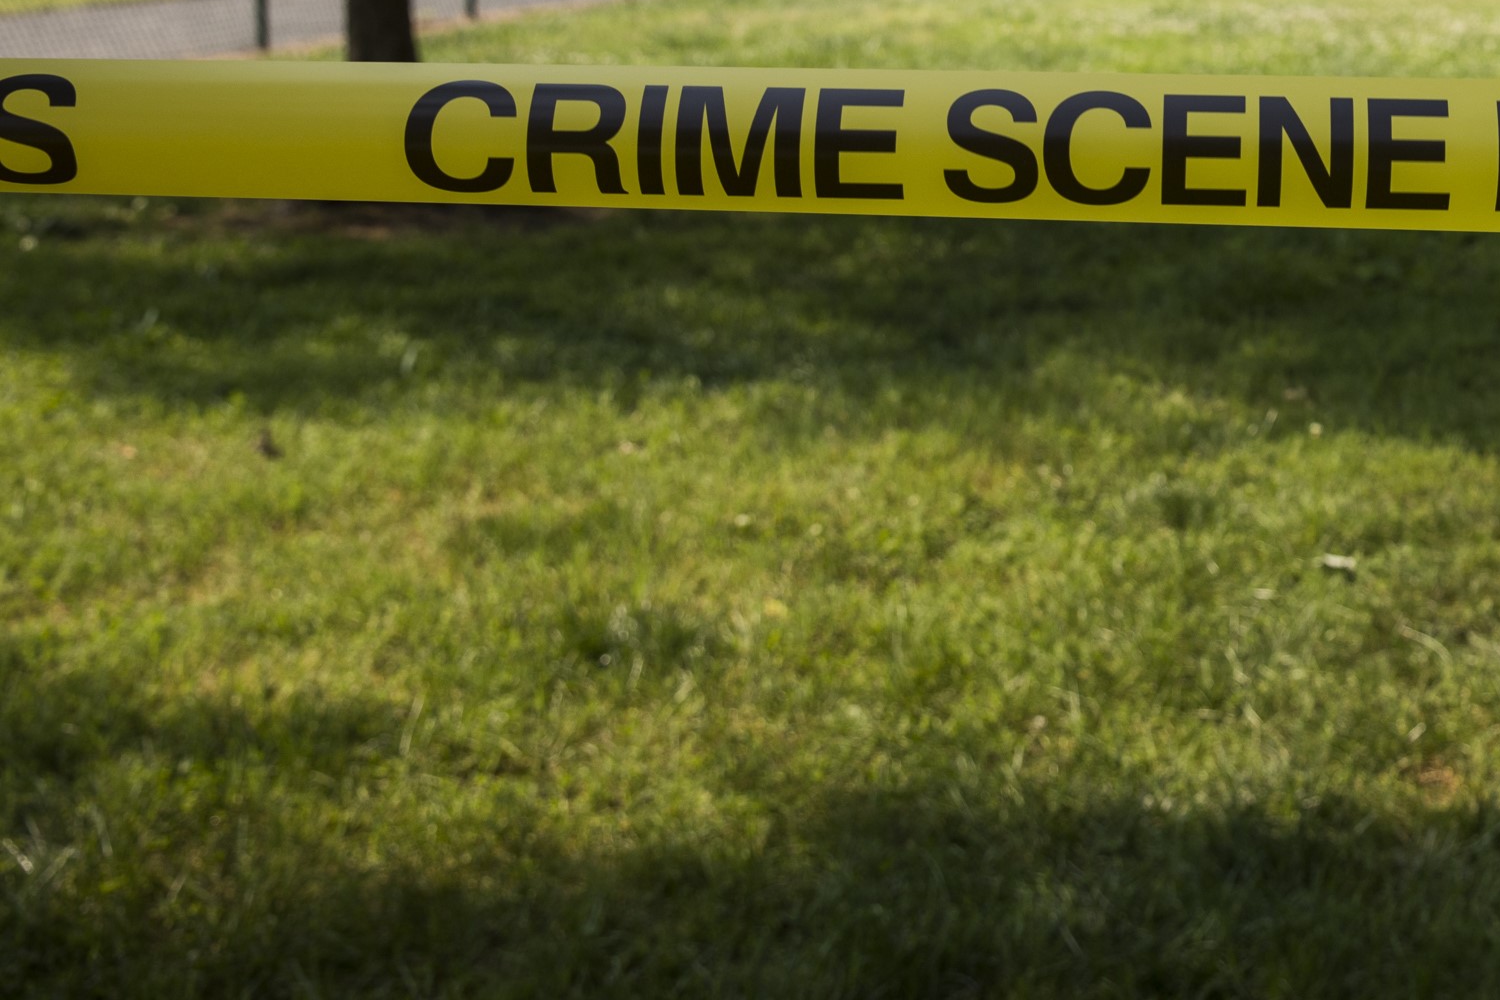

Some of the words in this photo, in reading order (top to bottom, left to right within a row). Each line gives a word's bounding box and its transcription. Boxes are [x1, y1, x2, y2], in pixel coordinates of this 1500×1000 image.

[0, 73, 78, 185] S
[403, 79, 905, 201] CRIME
[942, 88, 1451, 212] SCENE
